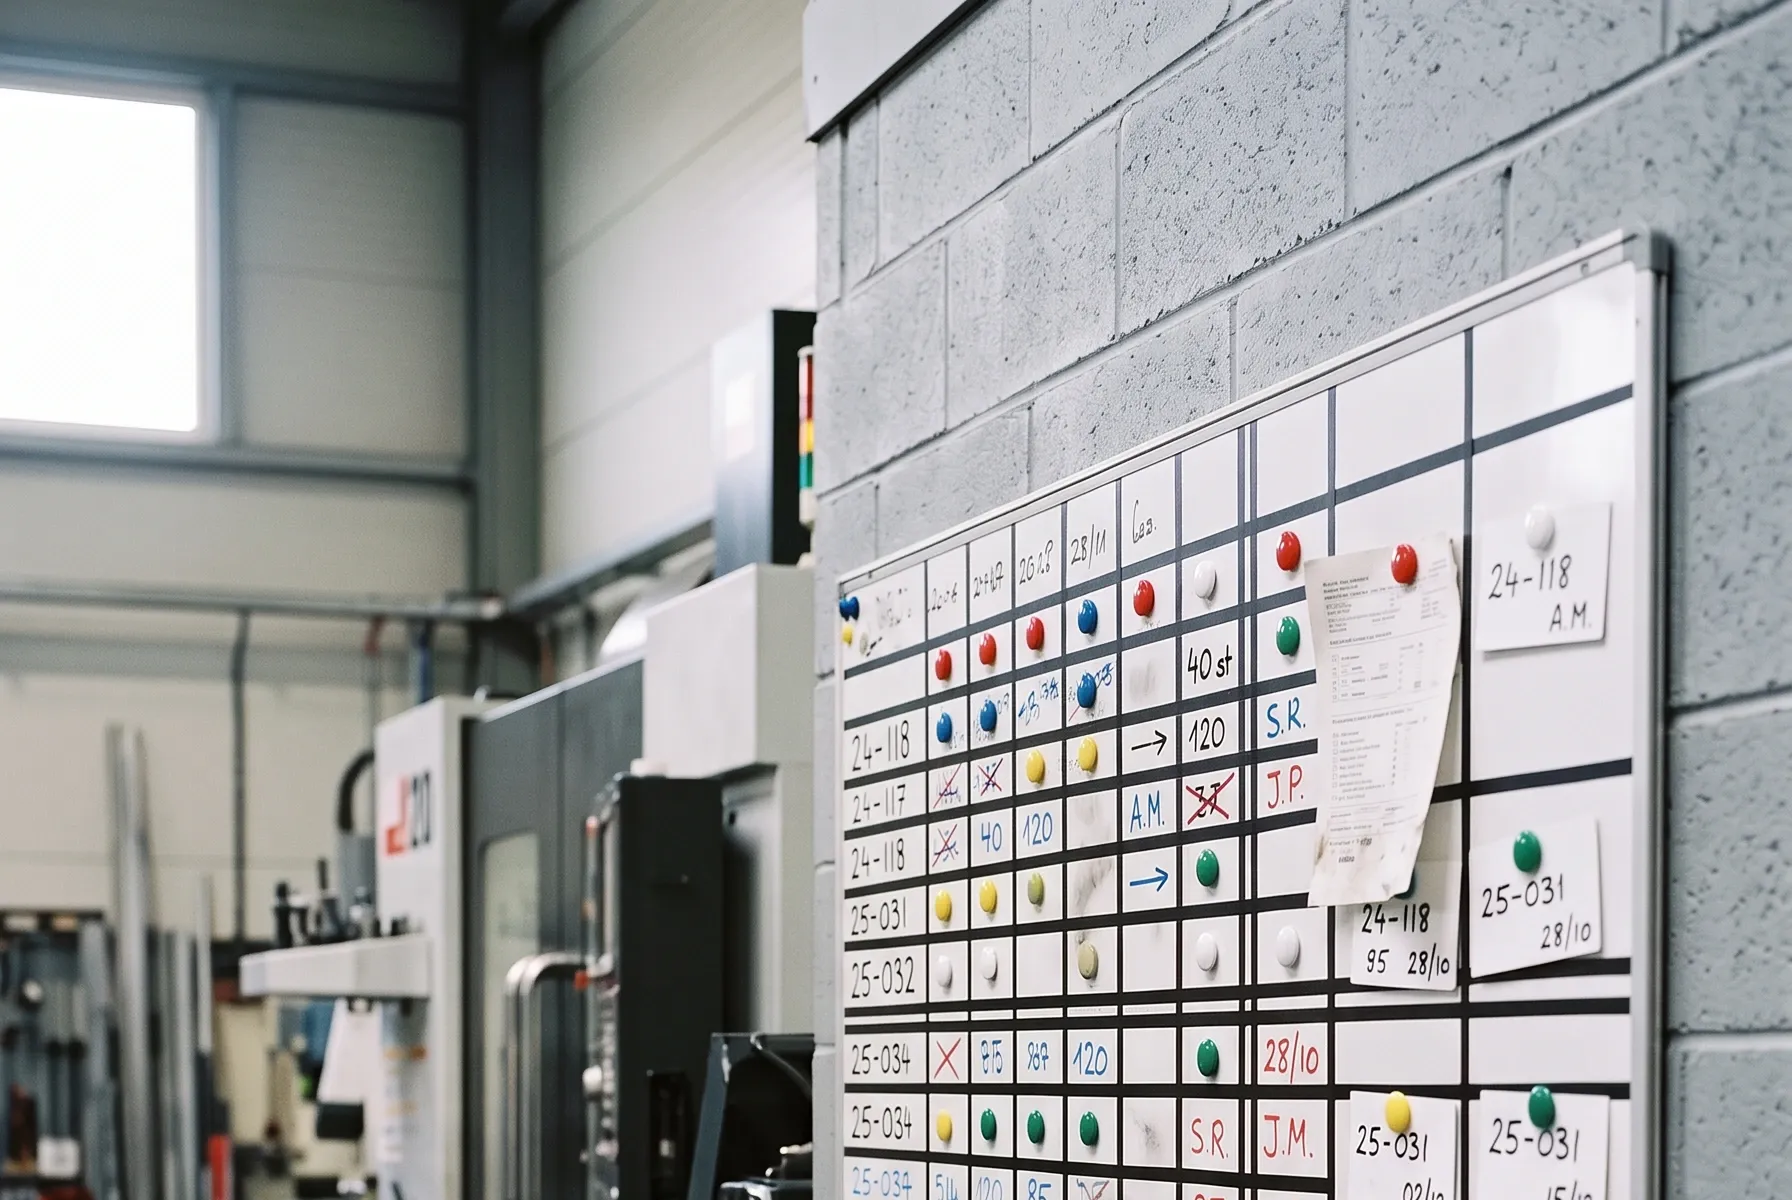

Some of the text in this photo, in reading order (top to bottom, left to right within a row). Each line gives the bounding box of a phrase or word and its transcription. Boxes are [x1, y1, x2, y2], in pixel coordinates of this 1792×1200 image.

[1070, 523, 1106, 570] 28/11
[1488, 553, 1572, 600] 24-118
[1549, 601, 1593, 632] A.M.
[1187, 643, 1233, 685] 40 st
[1188, 716, 1226, 753] 120
[1266, 696, 1306, 739] S.R.
[851, 720, 910, 772] 24-118
[852, 783, 906, 824] 24-117
[1266, 763, 1304, 809] J.P.
[1022, 811, 1053, 847] 120
[1129, 789, 1166, 833] A.M.
[981, 821, 1003, 853] 40
[851, 837, 905, 880] 24-118
[851, 896, 907, 936] 25-031
[1481, 873, 1565, 918] 25-031
[1361, 902, 1430, 935] 24-118
[1539, 912, 1591, 952] 28/10
[851, 956, 915, 999] 25-032
[1407, 942, 1450, 982] 28/10
[851, 1043, 911, 1076] 25-034
[1072, 1041, 1108, 1076] 120
[1263, 1030, 1319, 1084] 28/10
[851, 1105, 913, 1140] 25-034
[1190, 1117, 1229, 1160] S.R.
[1263, 1114, 1314, 1158] J.M.
[1355, 1124, 1428, 1163] 25-031
[1489, 1117, 1580, 1163] 25-031
